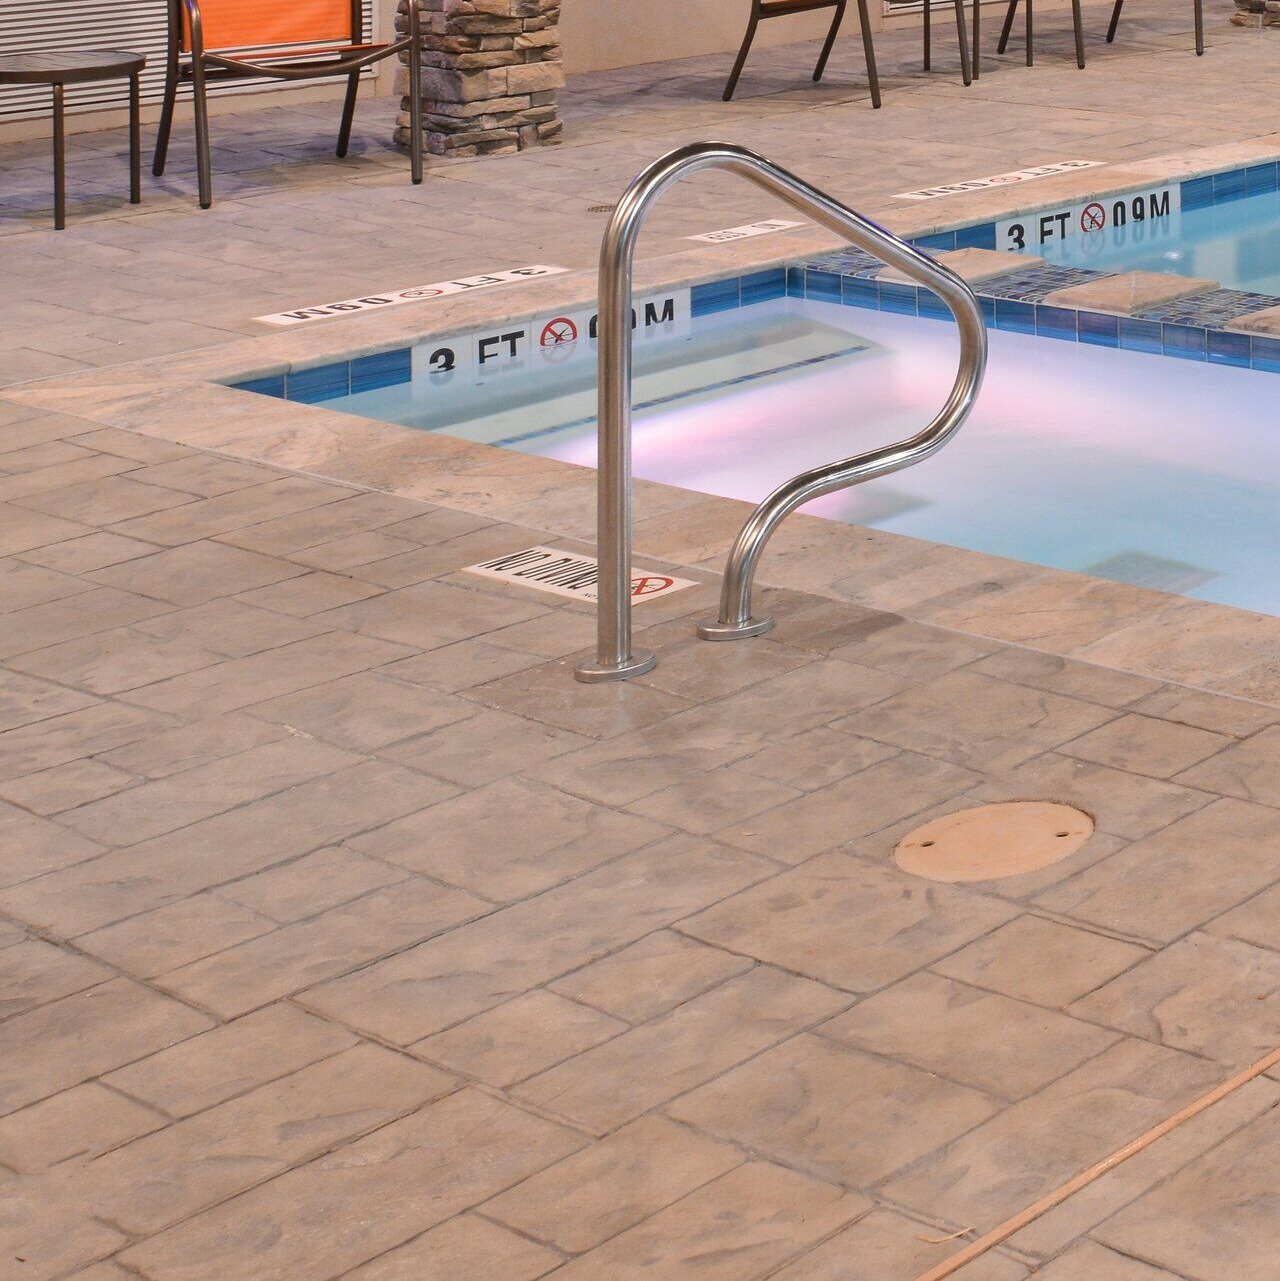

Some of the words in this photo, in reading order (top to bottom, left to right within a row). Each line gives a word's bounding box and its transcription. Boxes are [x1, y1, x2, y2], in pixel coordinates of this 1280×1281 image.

[1007, 223, 1026, 251] 3
[1039, 212, 1071, 244] FT
[451, 275, 506, 290] FT
[511, 267, 547, 277] 3
[429, 347, 457, 375] 3
[478, 330, 525, 365] FT
[478, 549, 552, 572] NO
